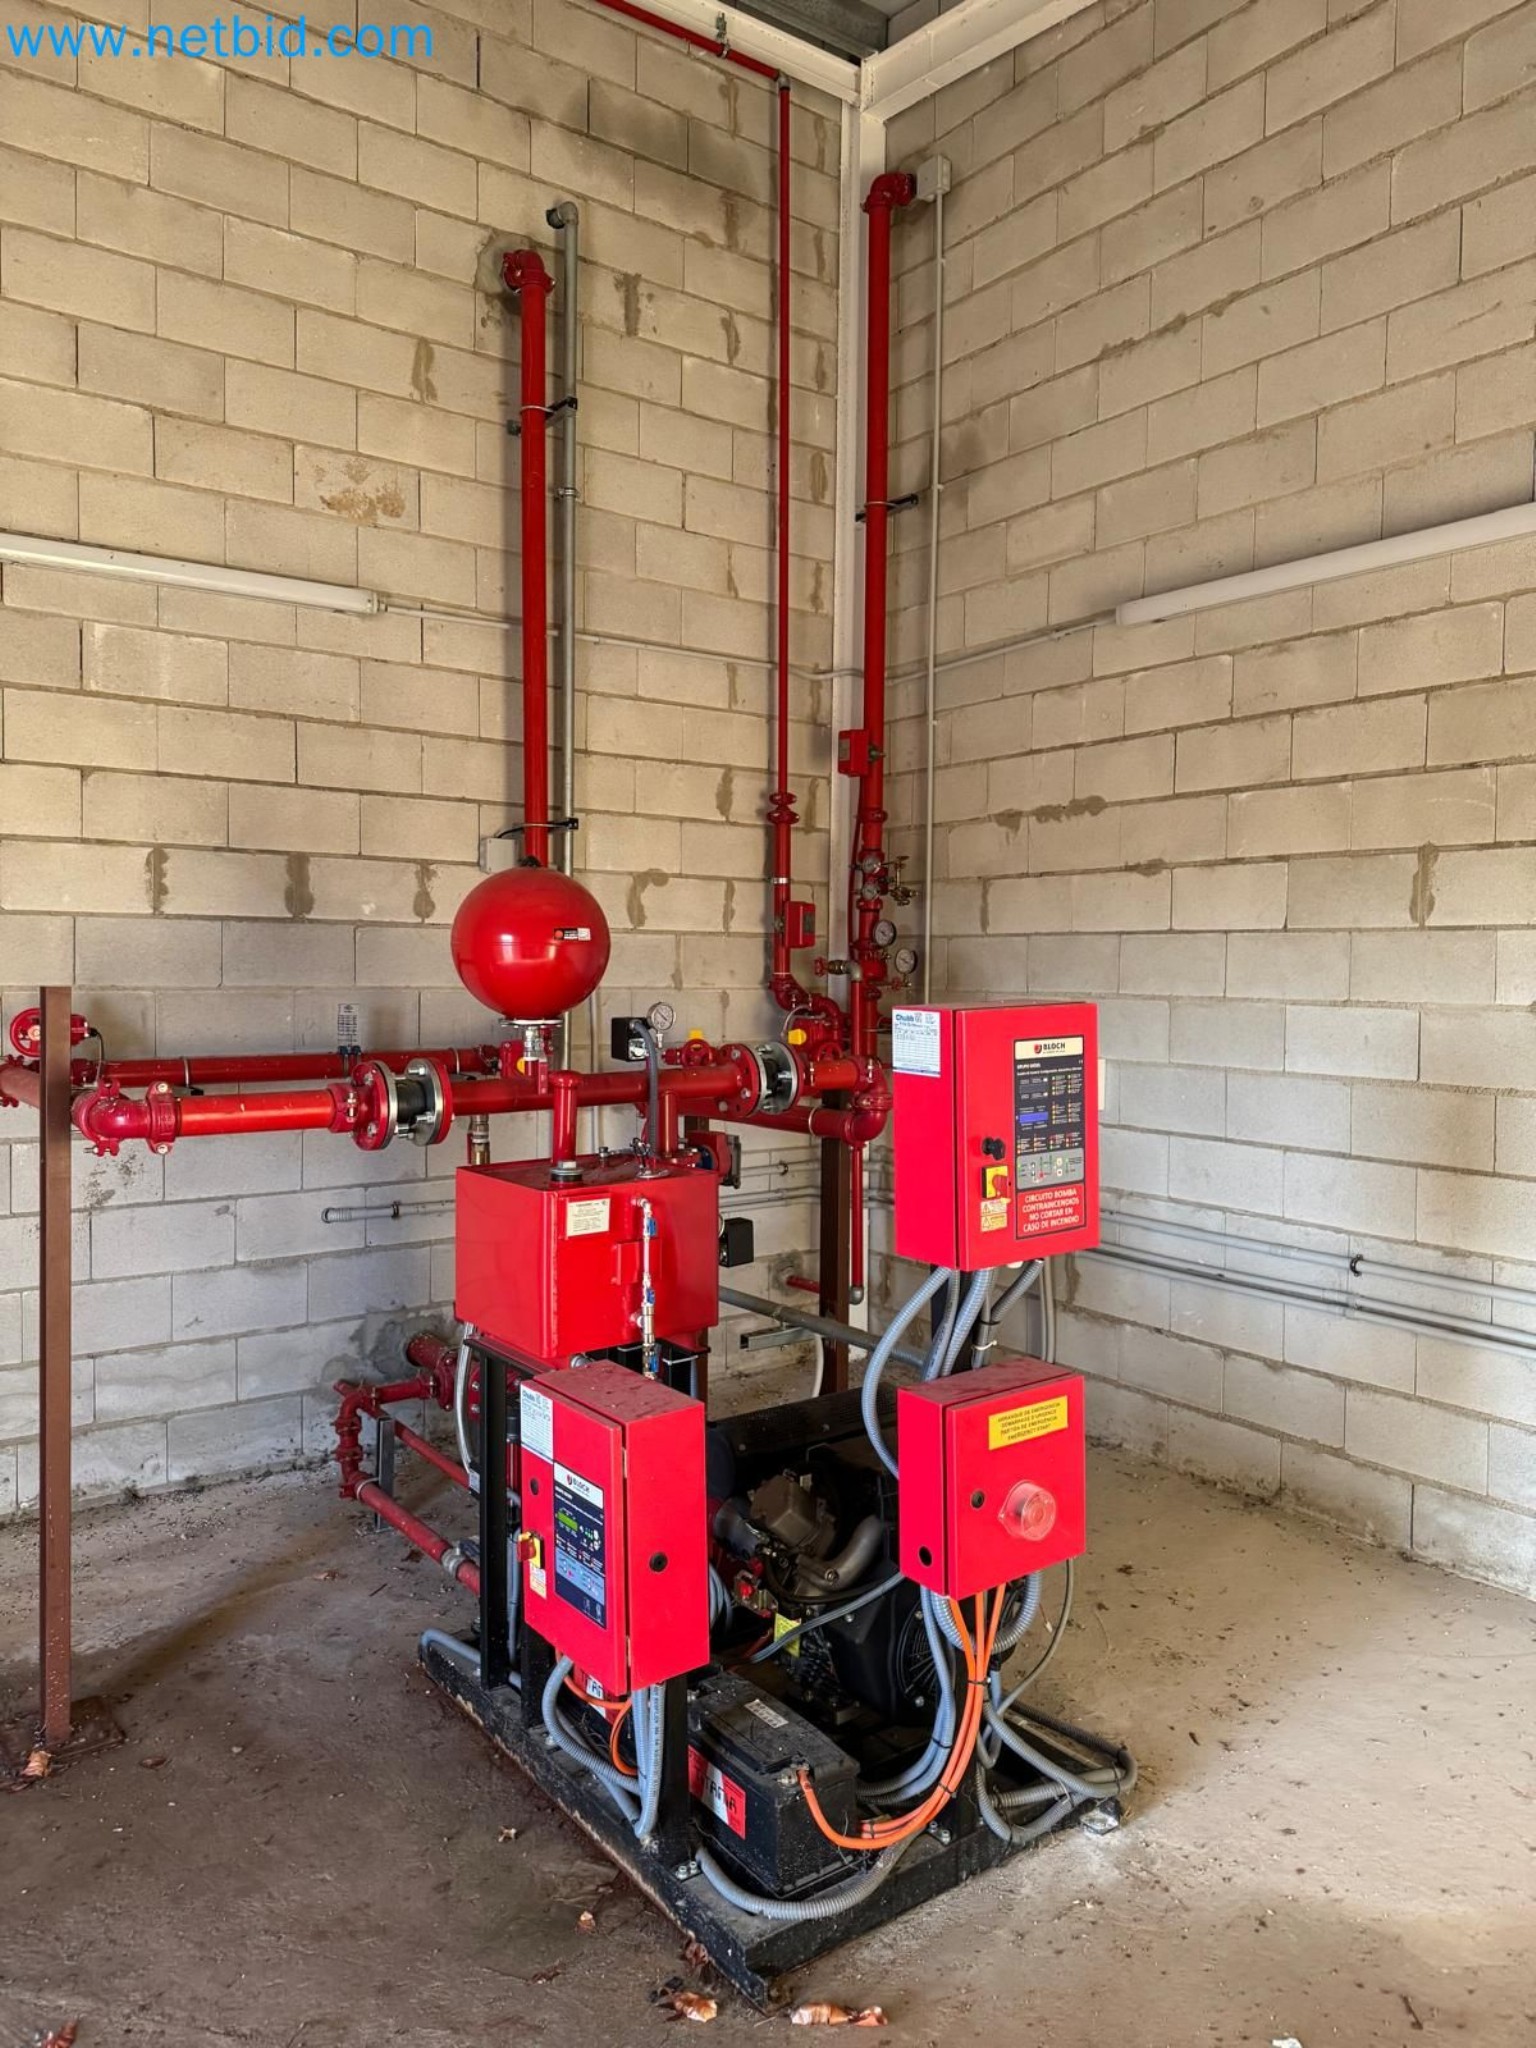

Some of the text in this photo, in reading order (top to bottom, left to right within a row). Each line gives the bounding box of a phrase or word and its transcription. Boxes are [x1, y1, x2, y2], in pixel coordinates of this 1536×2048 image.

[1025, 1188, 1077, 1203] CIRCUITO BOMBA
[1022, 1198, 1079, 1213] CONTRAINCENDIOS
[1029, 1206, 1073, 1221] NO CORTAR EN
[1023, 1215, 1079, 1232] CASO DE INCENDIO
